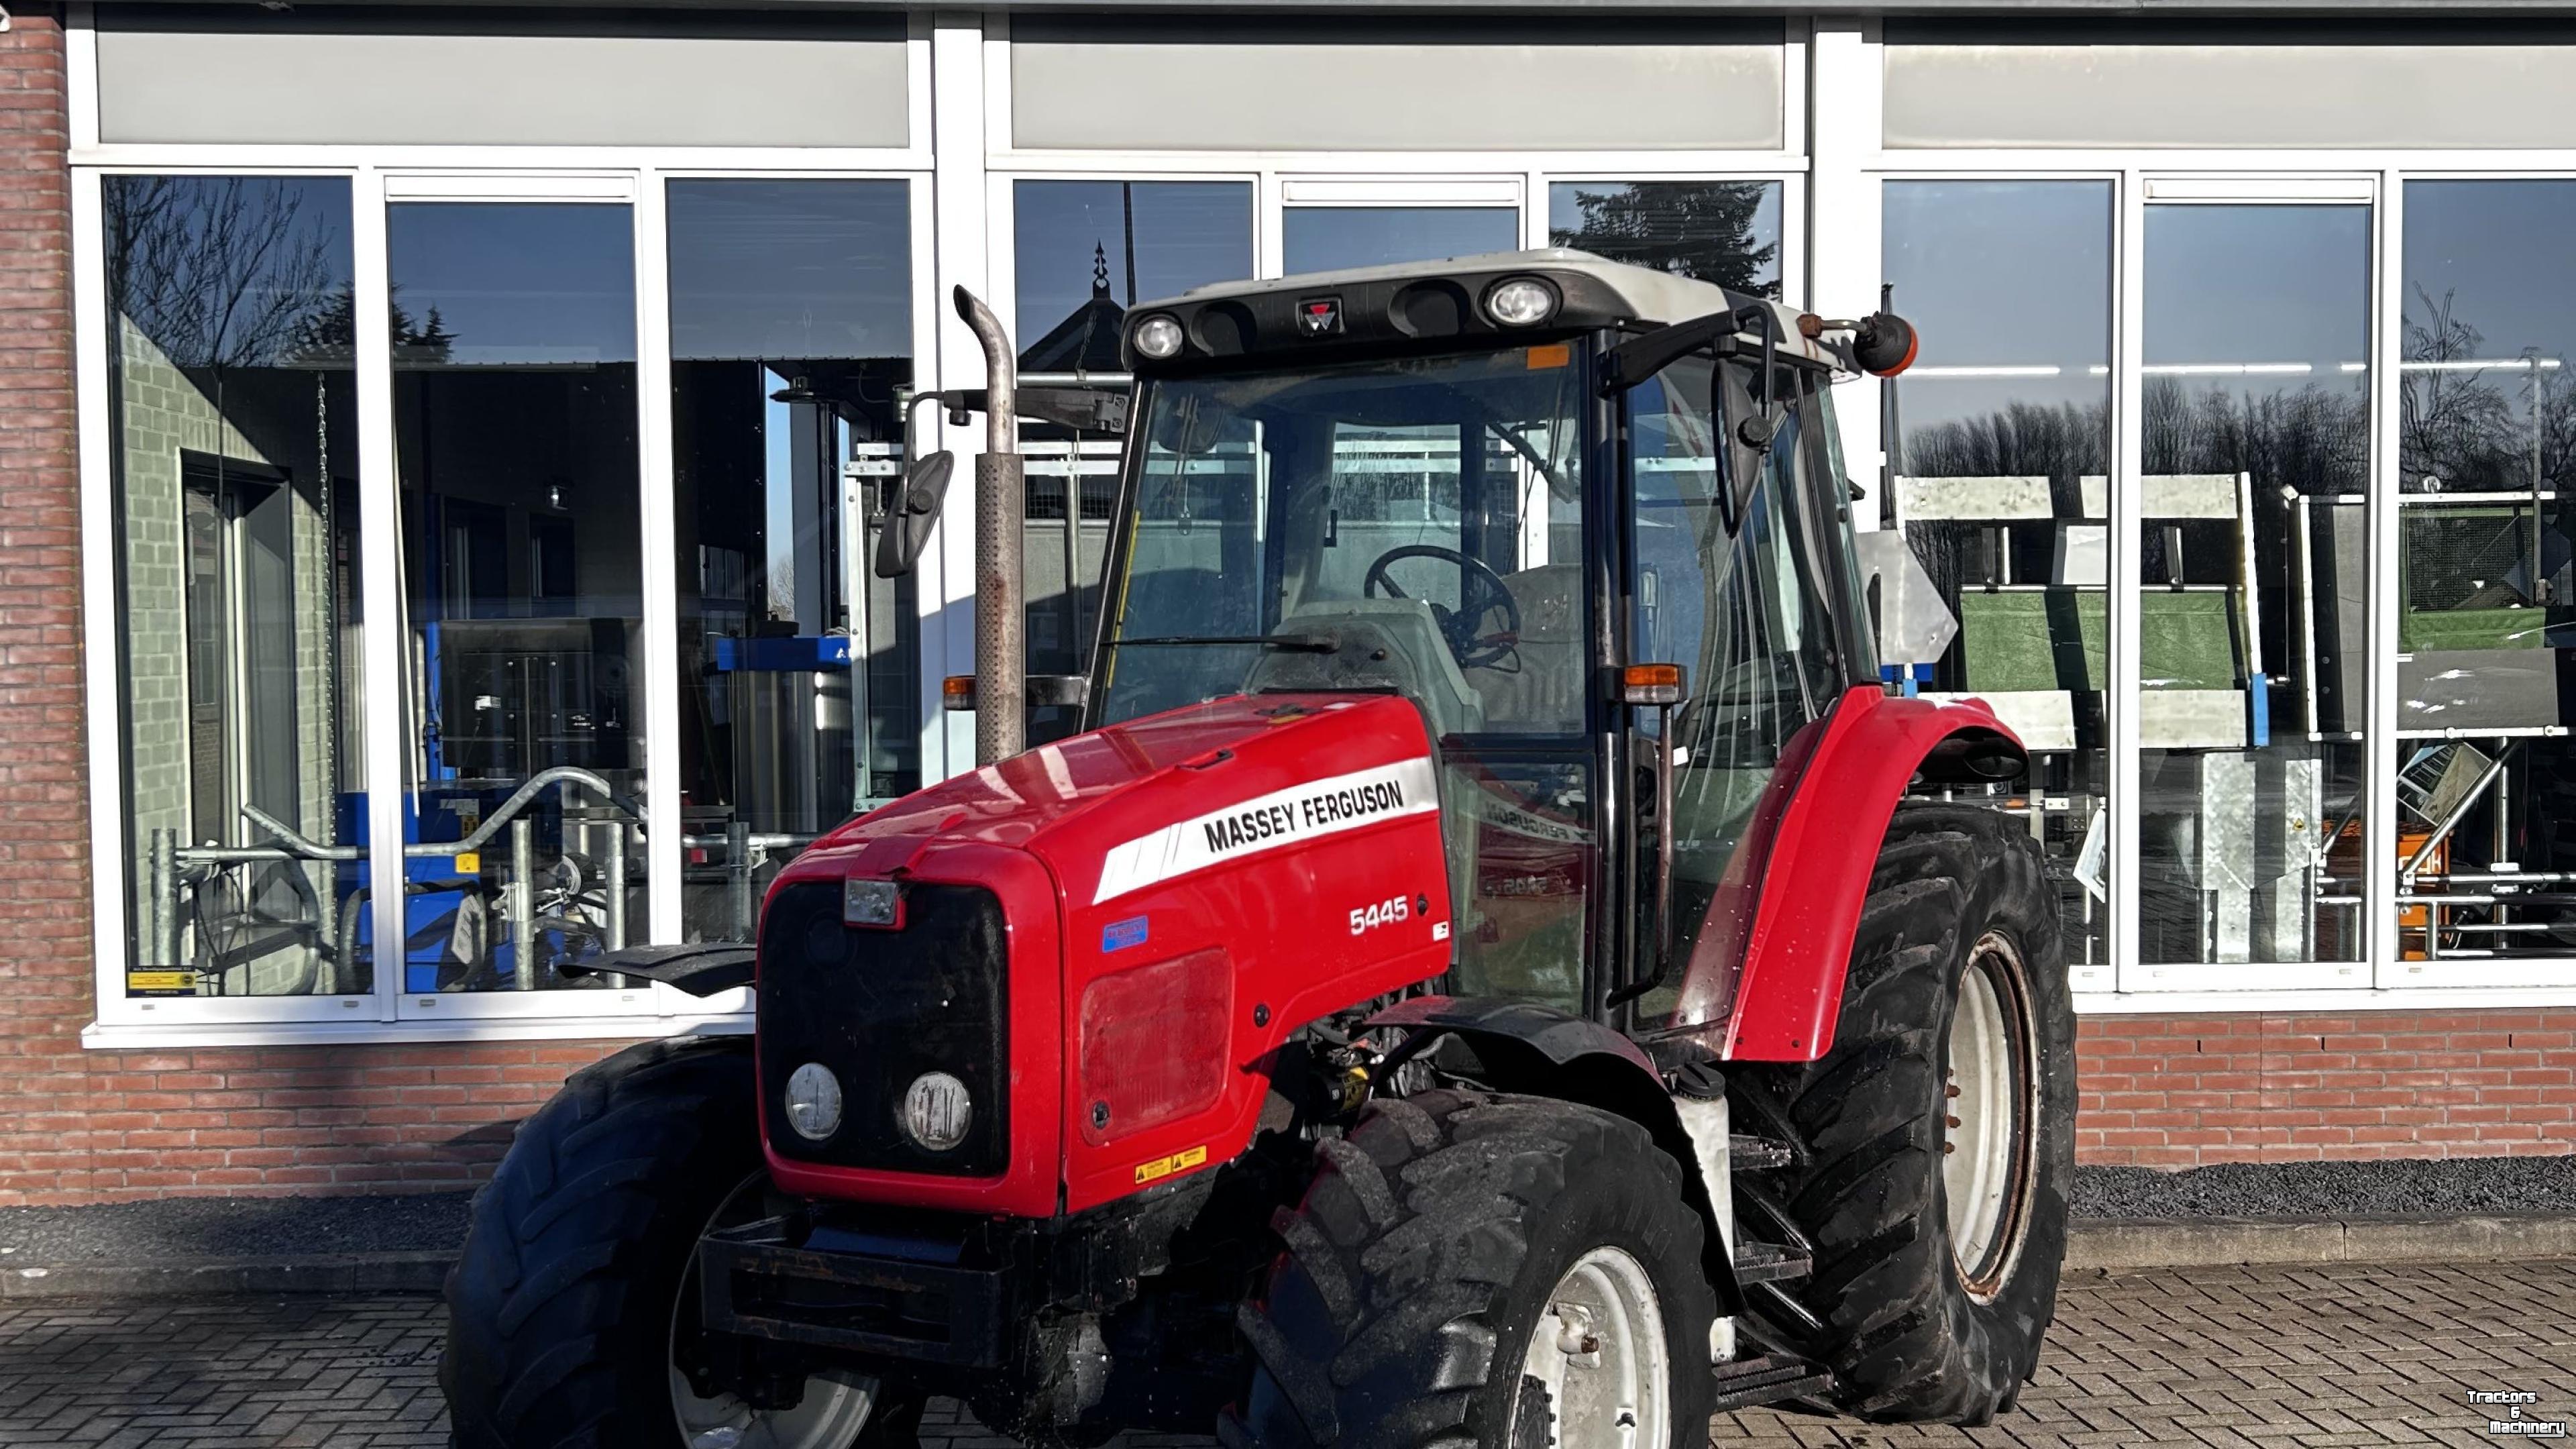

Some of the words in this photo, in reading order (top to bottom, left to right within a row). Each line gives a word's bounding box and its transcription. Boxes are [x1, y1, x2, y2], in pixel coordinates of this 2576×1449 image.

[1203, 802, 1295, 853] MASSEY
[1301, 780, 1404, 828] FERGUSON
[1350, 895, 1409, 936] 5445
